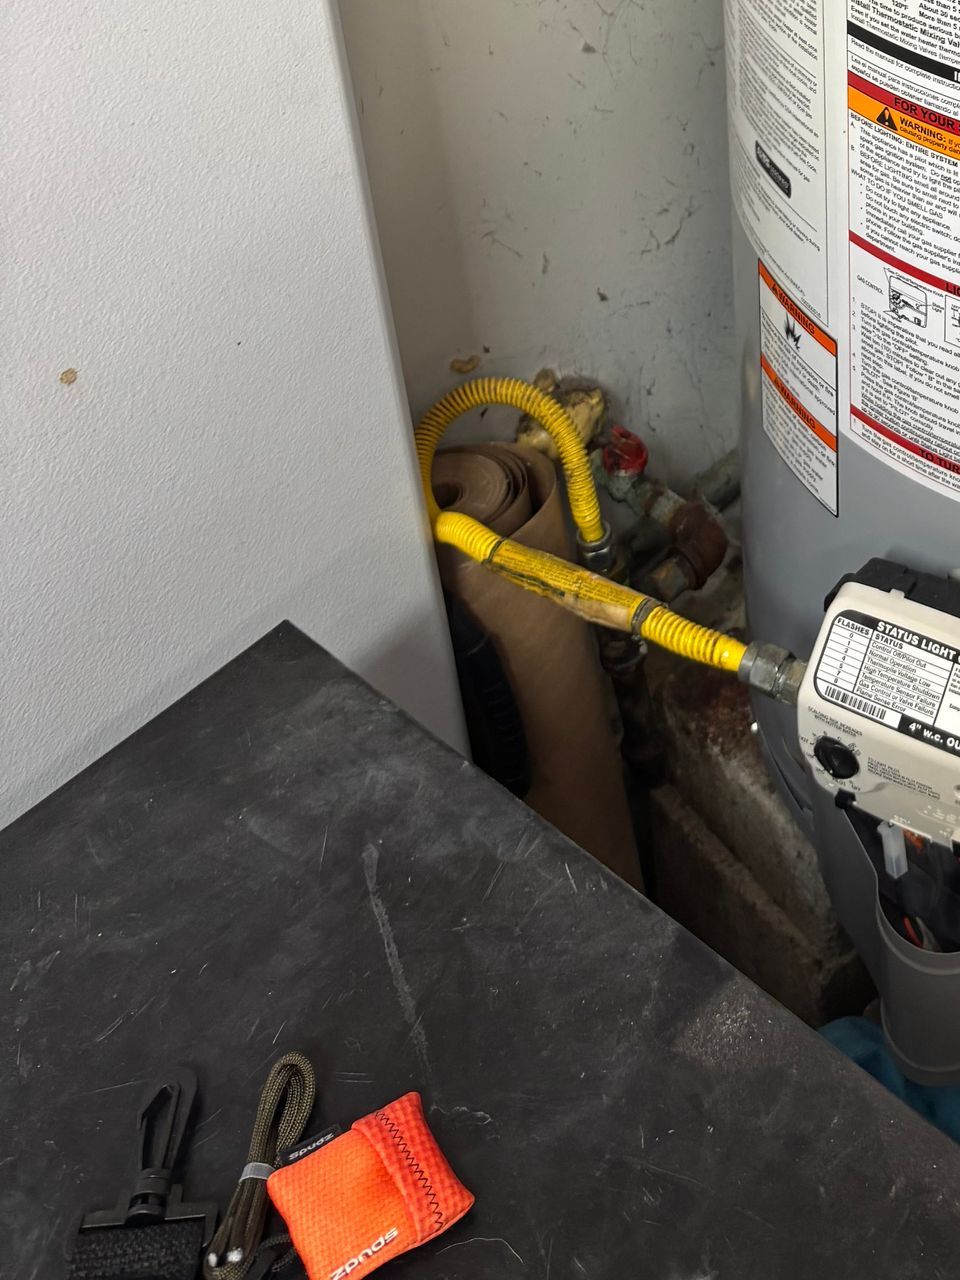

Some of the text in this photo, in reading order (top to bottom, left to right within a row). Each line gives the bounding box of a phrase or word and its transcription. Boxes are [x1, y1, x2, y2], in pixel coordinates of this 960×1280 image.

[894, 98, 917, 117] FOR
[920, 109, 955, 131] YOUR
[899, 117, 946, 143] WARNING:
[778, 293, 815, 335] WARNING
[919, 448, 934, 462] TO
[837, 617, 870, 636] FLASHES
[876, 621, 920, 646] STATUS
[920, 638, 957, 660] LIGHT
[870, 640, 928, 669] Control Off/Pilot Out
[874, 633, 904, 650] STATUS
[867, 655, 931, 688] Thermopile Voltage Low
[868, 649, 917, 674] Normal Operation
[861, 671, 936, 709] Temperature Sensor Failure
[863, 664, 941, 701] High Temperature Shutdown
[855, 686, 908, 713] Flame Sense Error
[908, 722, 922, 732] 4"
[923, 728, 944, 743] w.c.
